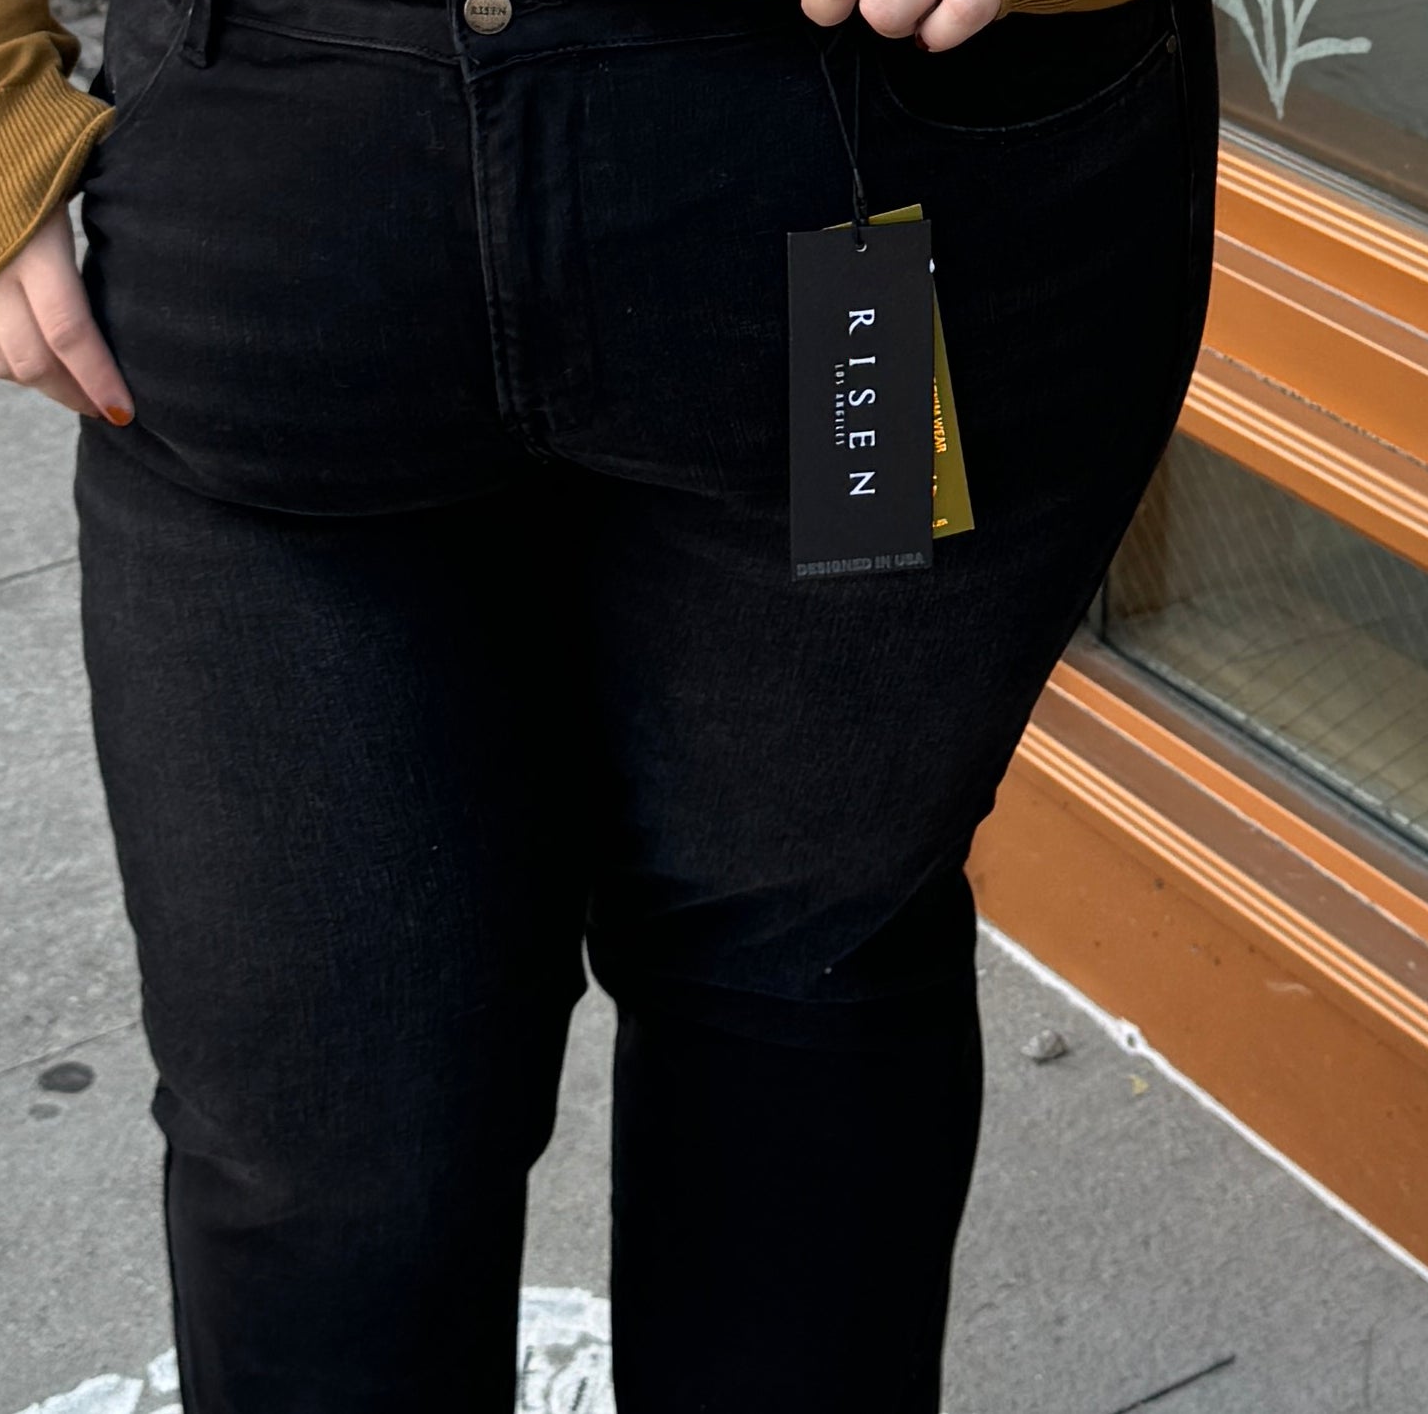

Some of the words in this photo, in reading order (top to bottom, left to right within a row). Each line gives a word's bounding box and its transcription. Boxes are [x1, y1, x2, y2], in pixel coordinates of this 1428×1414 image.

[470, 5, 507, 16] RISEN
[834, 363, 845, 385] LOS
[847, 308, 876, 497] RISEN
[834, 393, 845, 446] ANGELES
[933, 418, 948, 454] WEAR
[795, 558, 872, 577] DESIGNED
[874, 554, 891, 569] IN
[894, 551, 925, 567] USA
